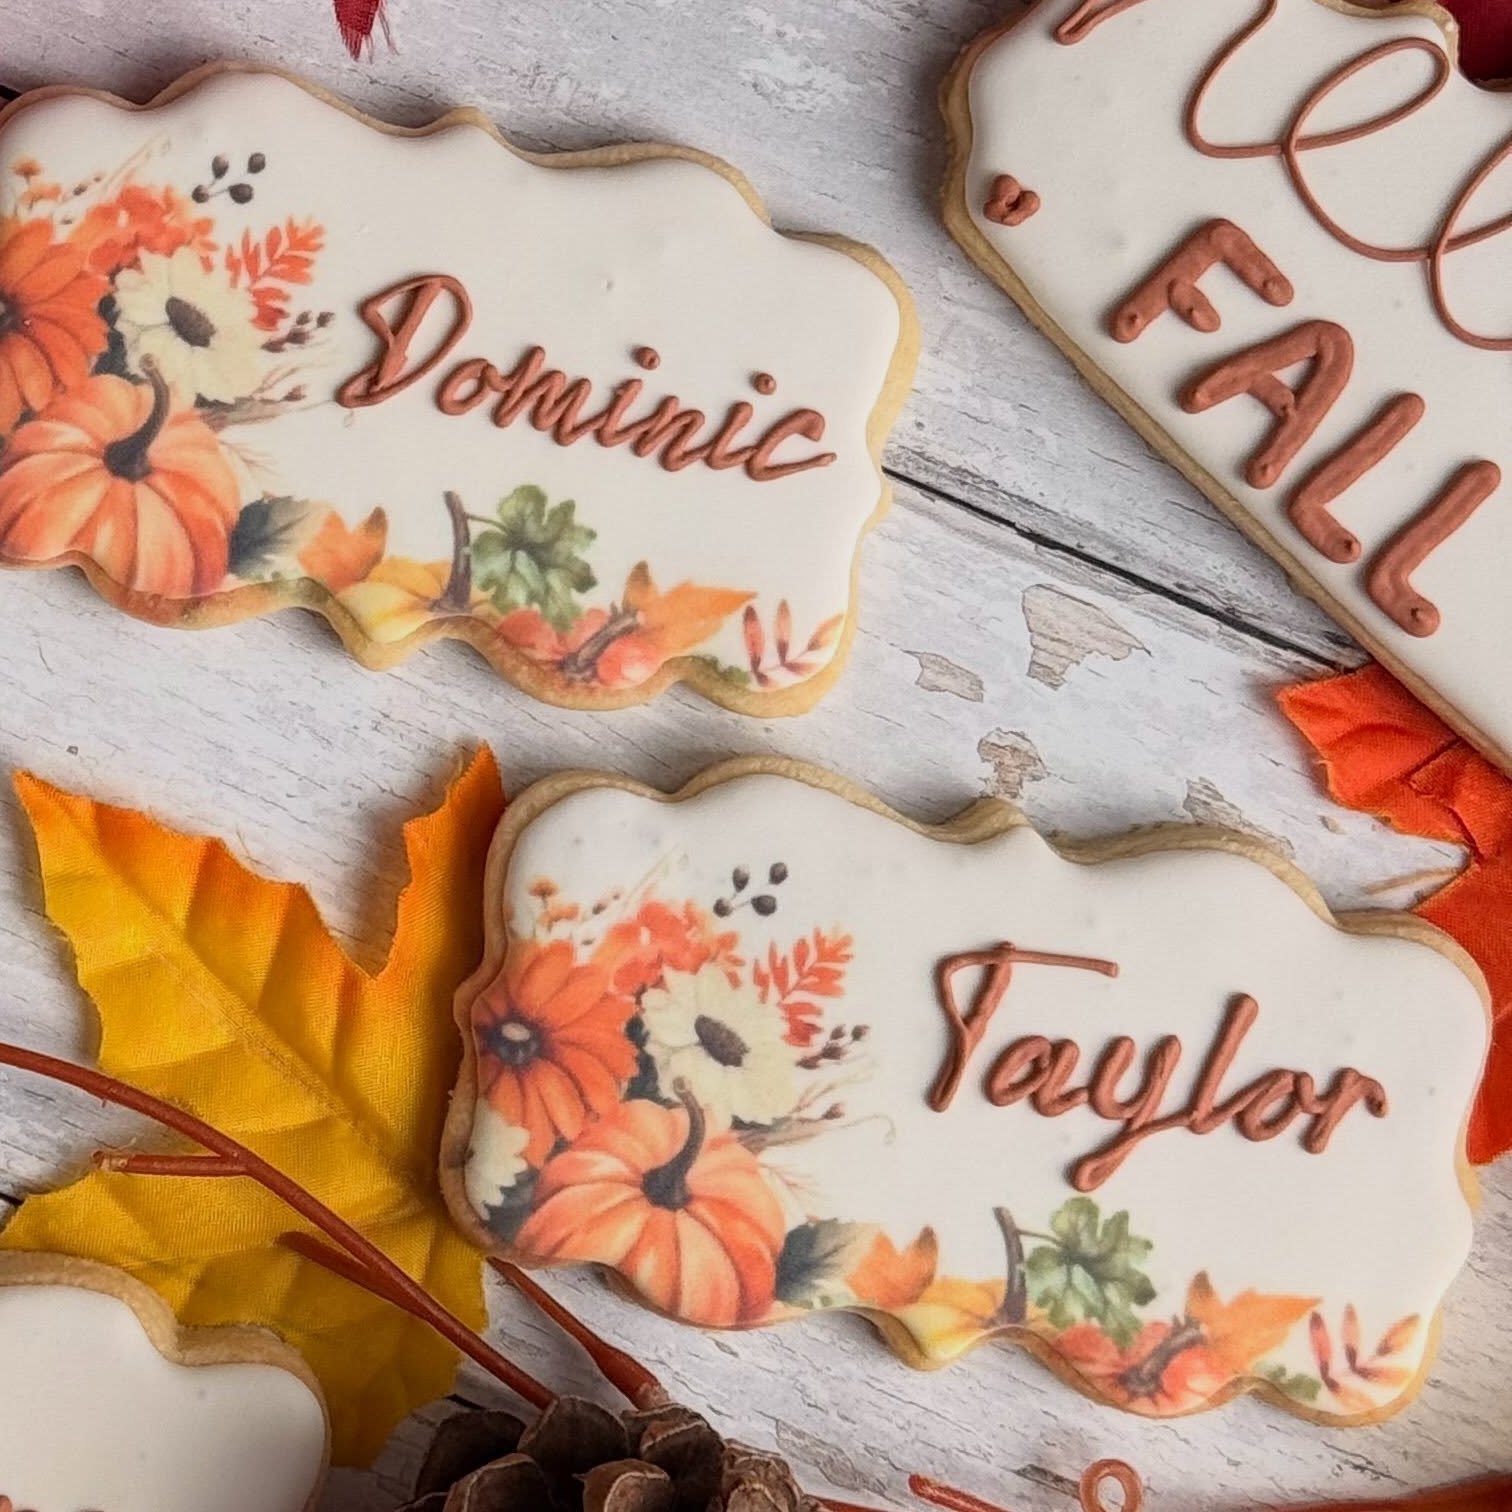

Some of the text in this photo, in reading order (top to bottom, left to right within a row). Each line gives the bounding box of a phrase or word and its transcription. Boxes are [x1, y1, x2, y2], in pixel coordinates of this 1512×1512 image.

[337, 274, 837, 481] Dominic
[1108, 218, 1501, 638] FALL
[925, 941, 1388, 1192] Taylor
